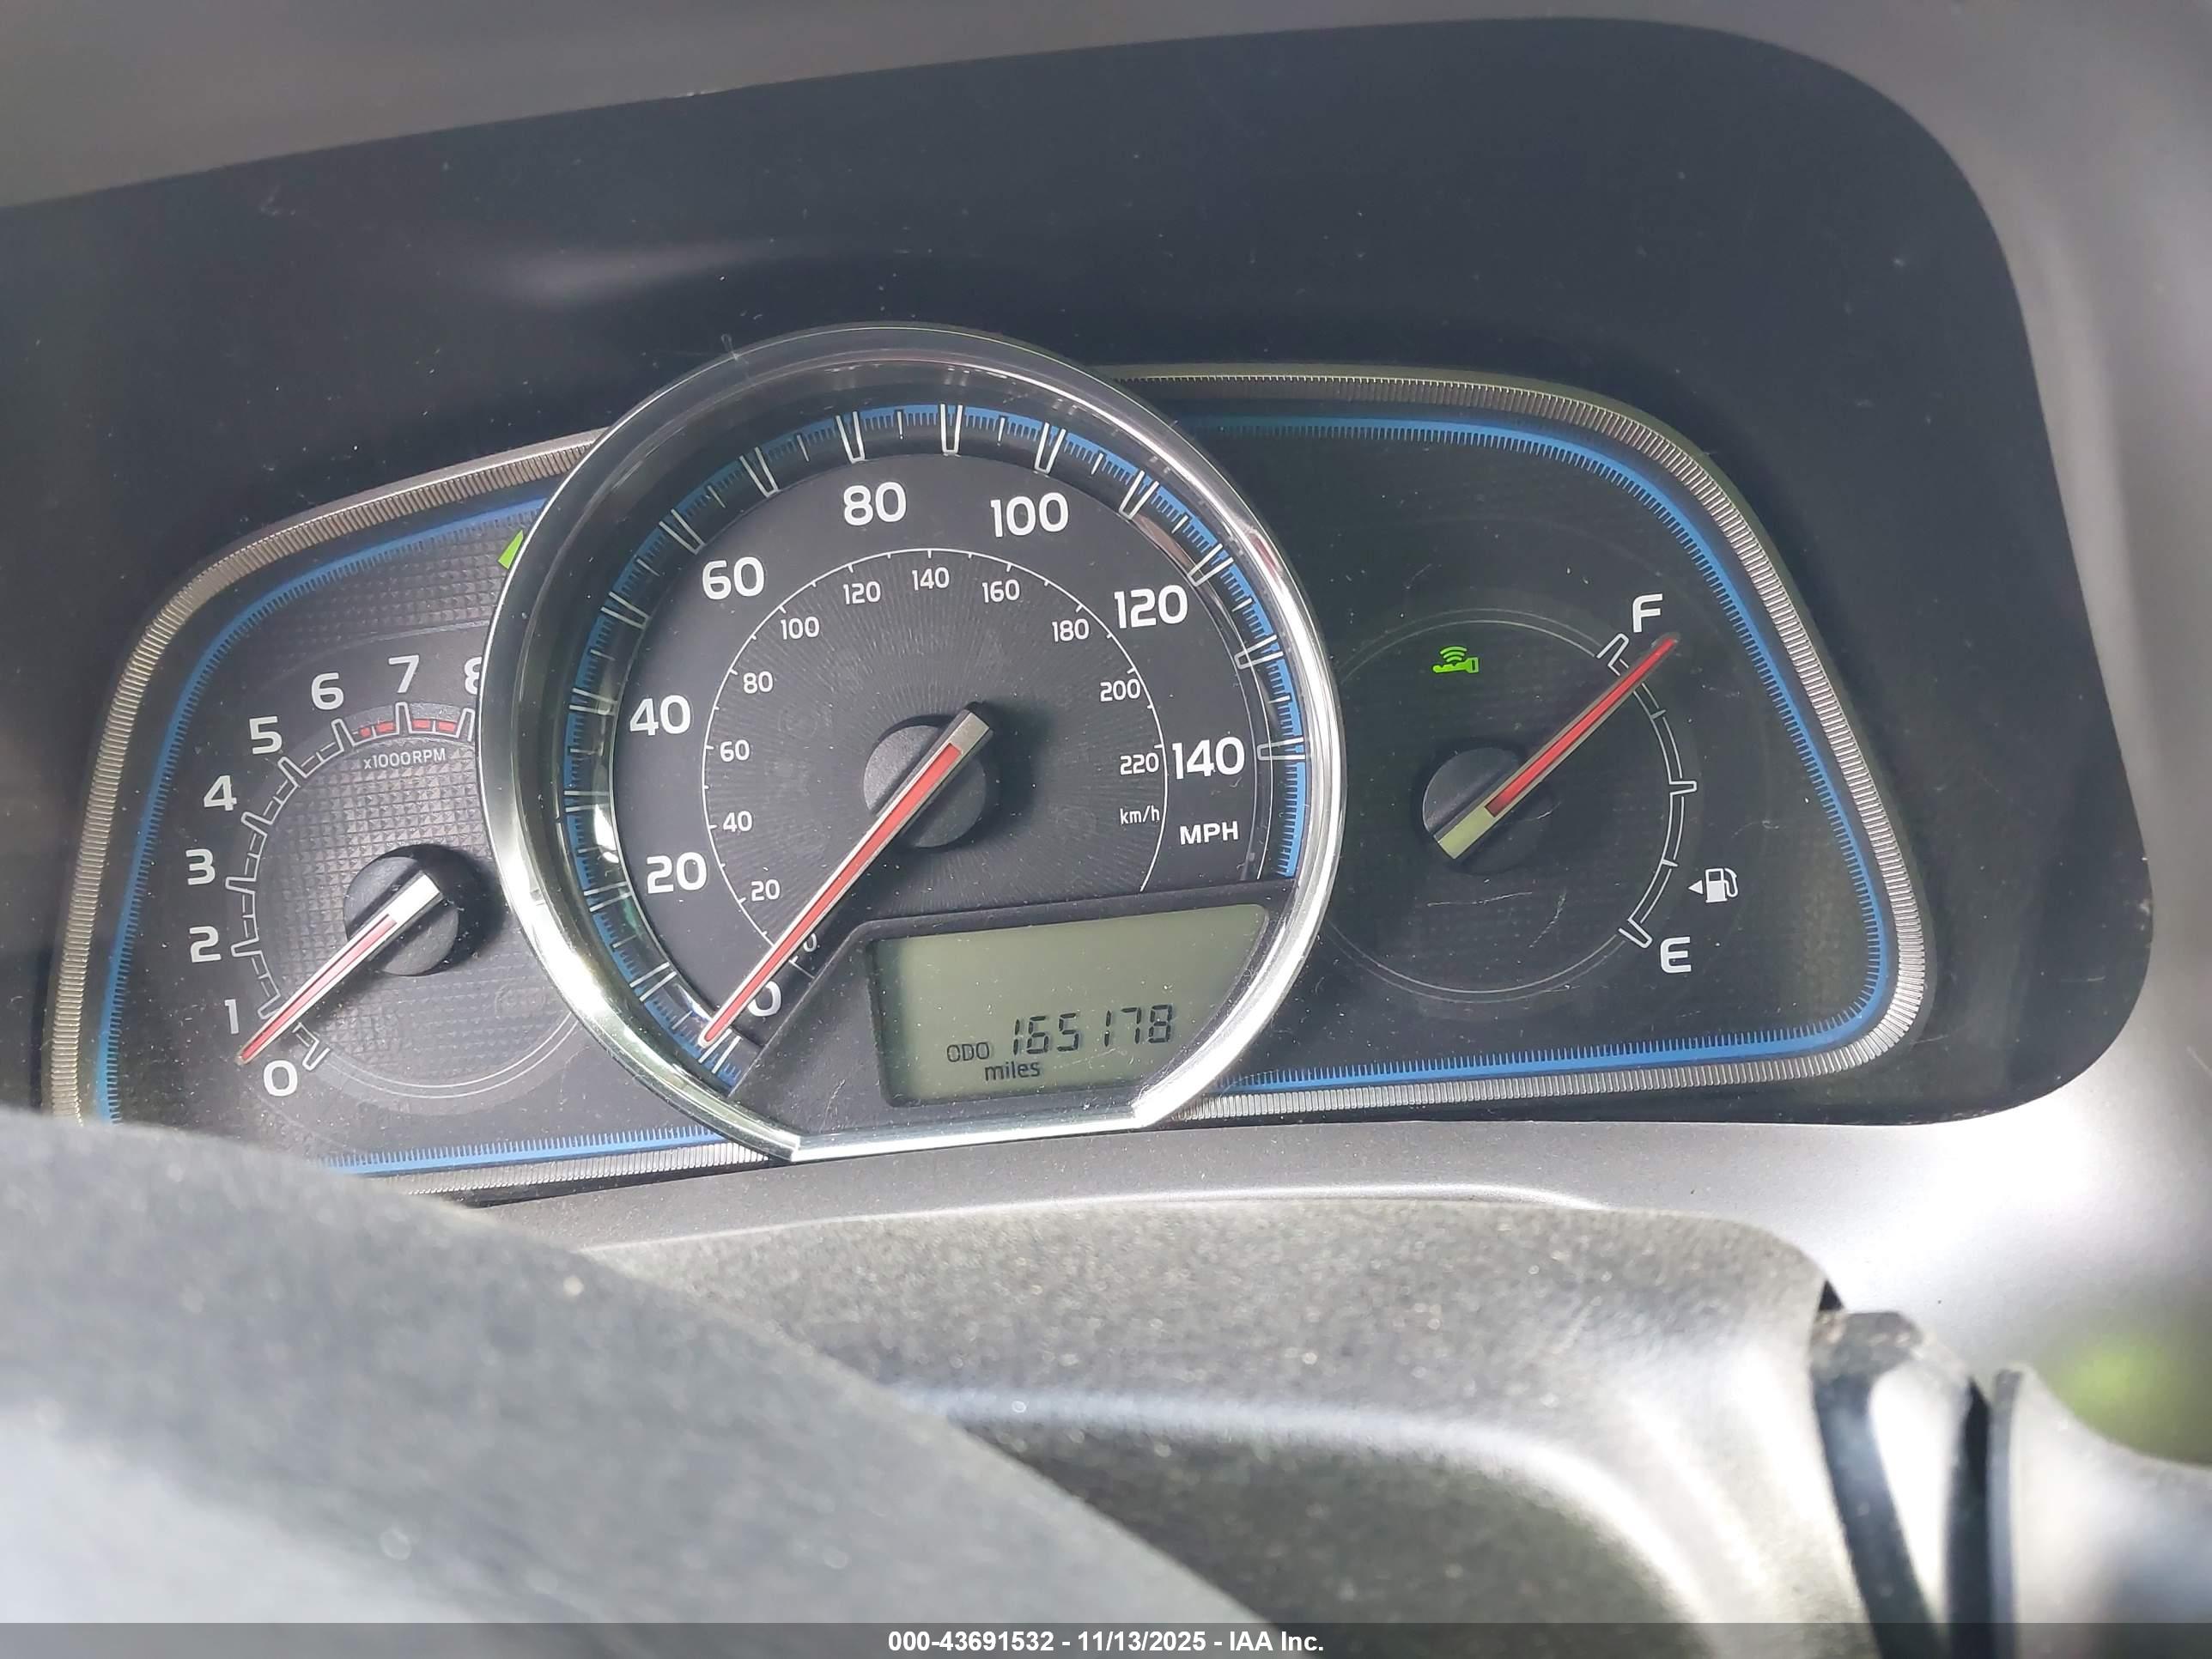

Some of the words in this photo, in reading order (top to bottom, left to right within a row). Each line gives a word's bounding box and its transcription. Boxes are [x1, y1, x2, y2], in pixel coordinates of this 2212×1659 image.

[842, 482, 907, 526] 80
[990, 492, 1069, 538] 100
[702, 556, 765, 600] 60
[842, 581, 881, 605] 120
[912, 567, 950, 591] 140
[981, 579, 1020, 603] 160
[1114, 584, 1188, 629] 120
[1632, 593, 1663, 633] F
[780, 616, 820, 640] 100
[1051, 617, 1090, 642] 180
[312, 672, 344, 710] 6
[387, 655, 421, 693] 7
[743, 671, 773, 694] 80
[1099, 678, 1141, 702] 200
[629, 695, 691, 736] 40
[249, 715, 282, 755] 5
[720, 739, 750, 762] 60
[1120, 752, 1159, 775] 220
[1171, 736, 1245, 780] 140
[203, 775, 238, 811] 4
[722, 811, 752, 833] 40
[1120, 806, 1161, 825] km/h
[1179, 821, 1239, 845] MPH
[186, 848, 216, 885] 3
[647, 852, 708, 894] 20
[750, 878, 781, 902] 20
[190, 926, 222, 963] 2
[1660, 937, 1692, 974] E
[224, 999, 239, 1034] 1
[746, 981, 781, 1017] 0
[946, 1042, 990, 1063] ODO
[1012, 1004, 1173, 1057] 165178
[263, 1060, 298, 1097] 0
[984, 1060, 1041, 1081] miles
